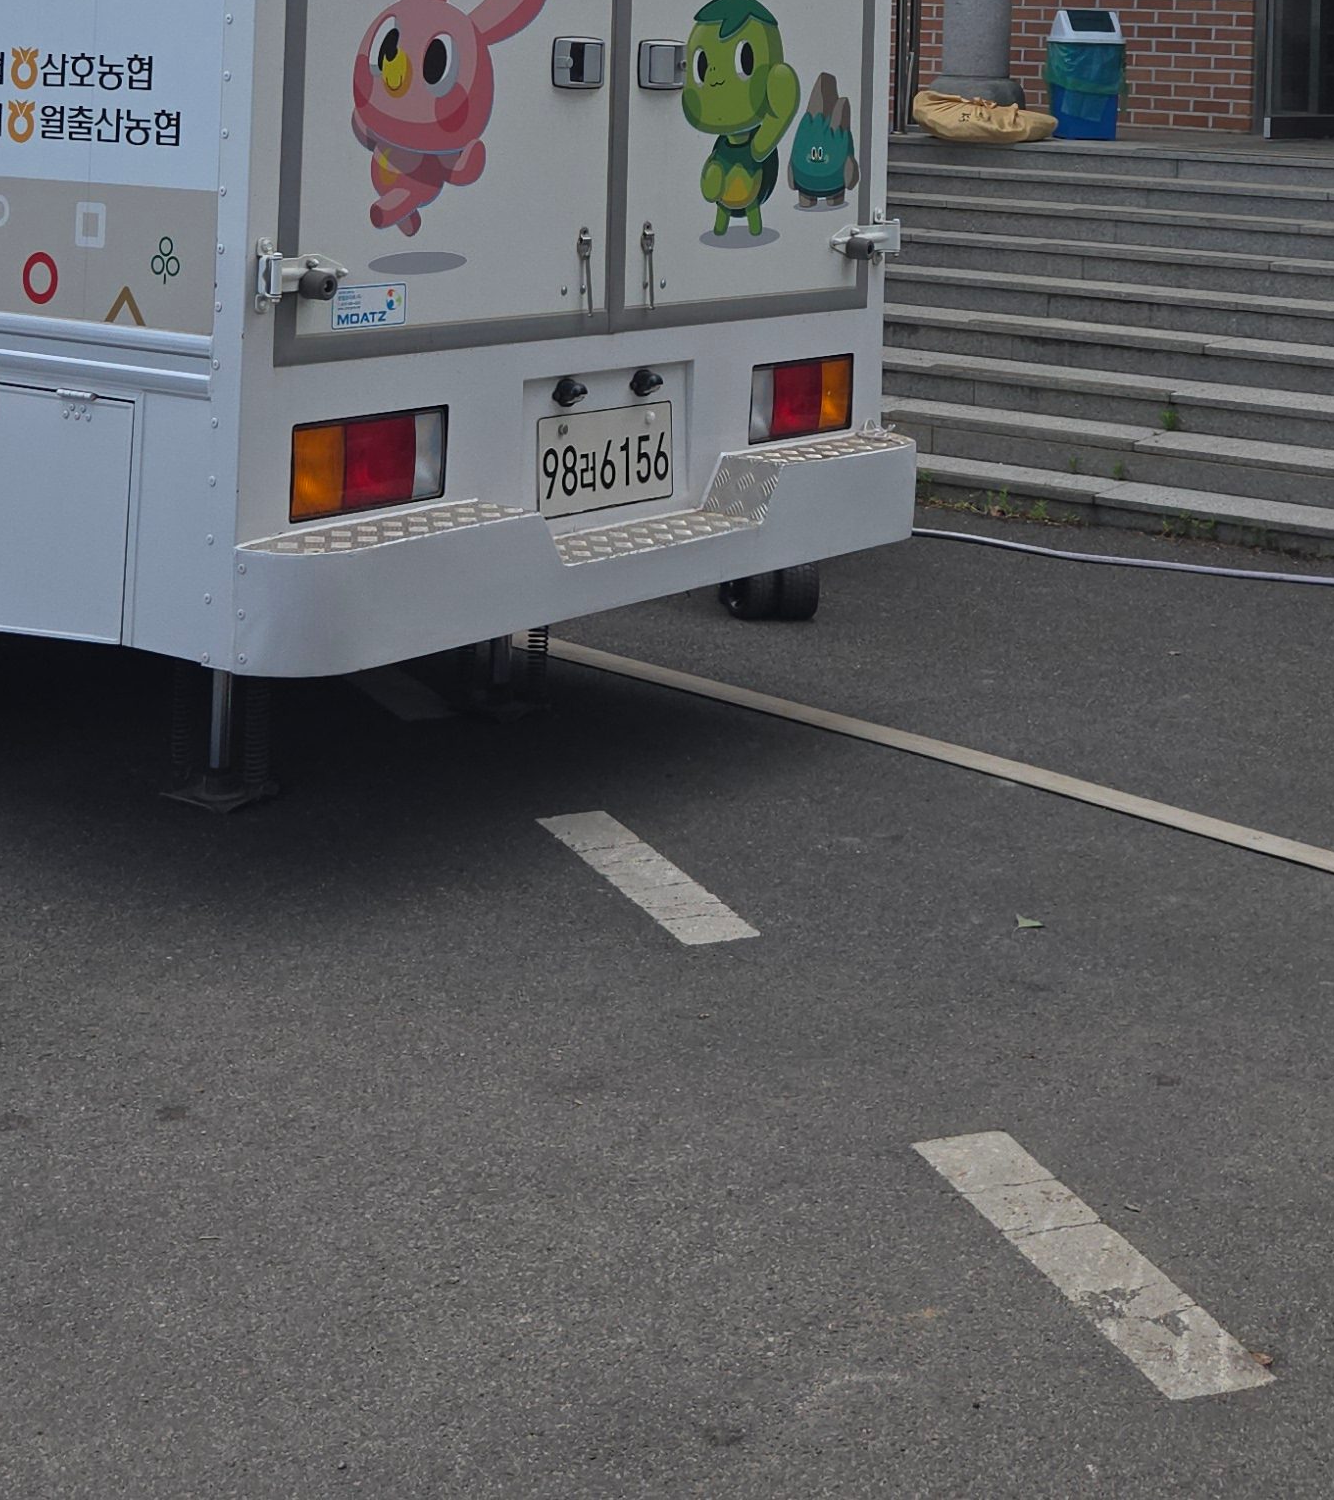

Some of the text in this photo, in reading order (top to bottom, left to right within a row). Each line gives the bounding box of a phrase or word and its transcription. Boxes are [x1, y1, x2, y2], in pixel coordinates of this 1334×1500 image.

[40, 52, 154, 91] 삼호농협
[40, 104, 181, 147] 월출산농협
[337, 311, 387, 326] MOATZ
[543, 431, 669, 500] 98러6156
